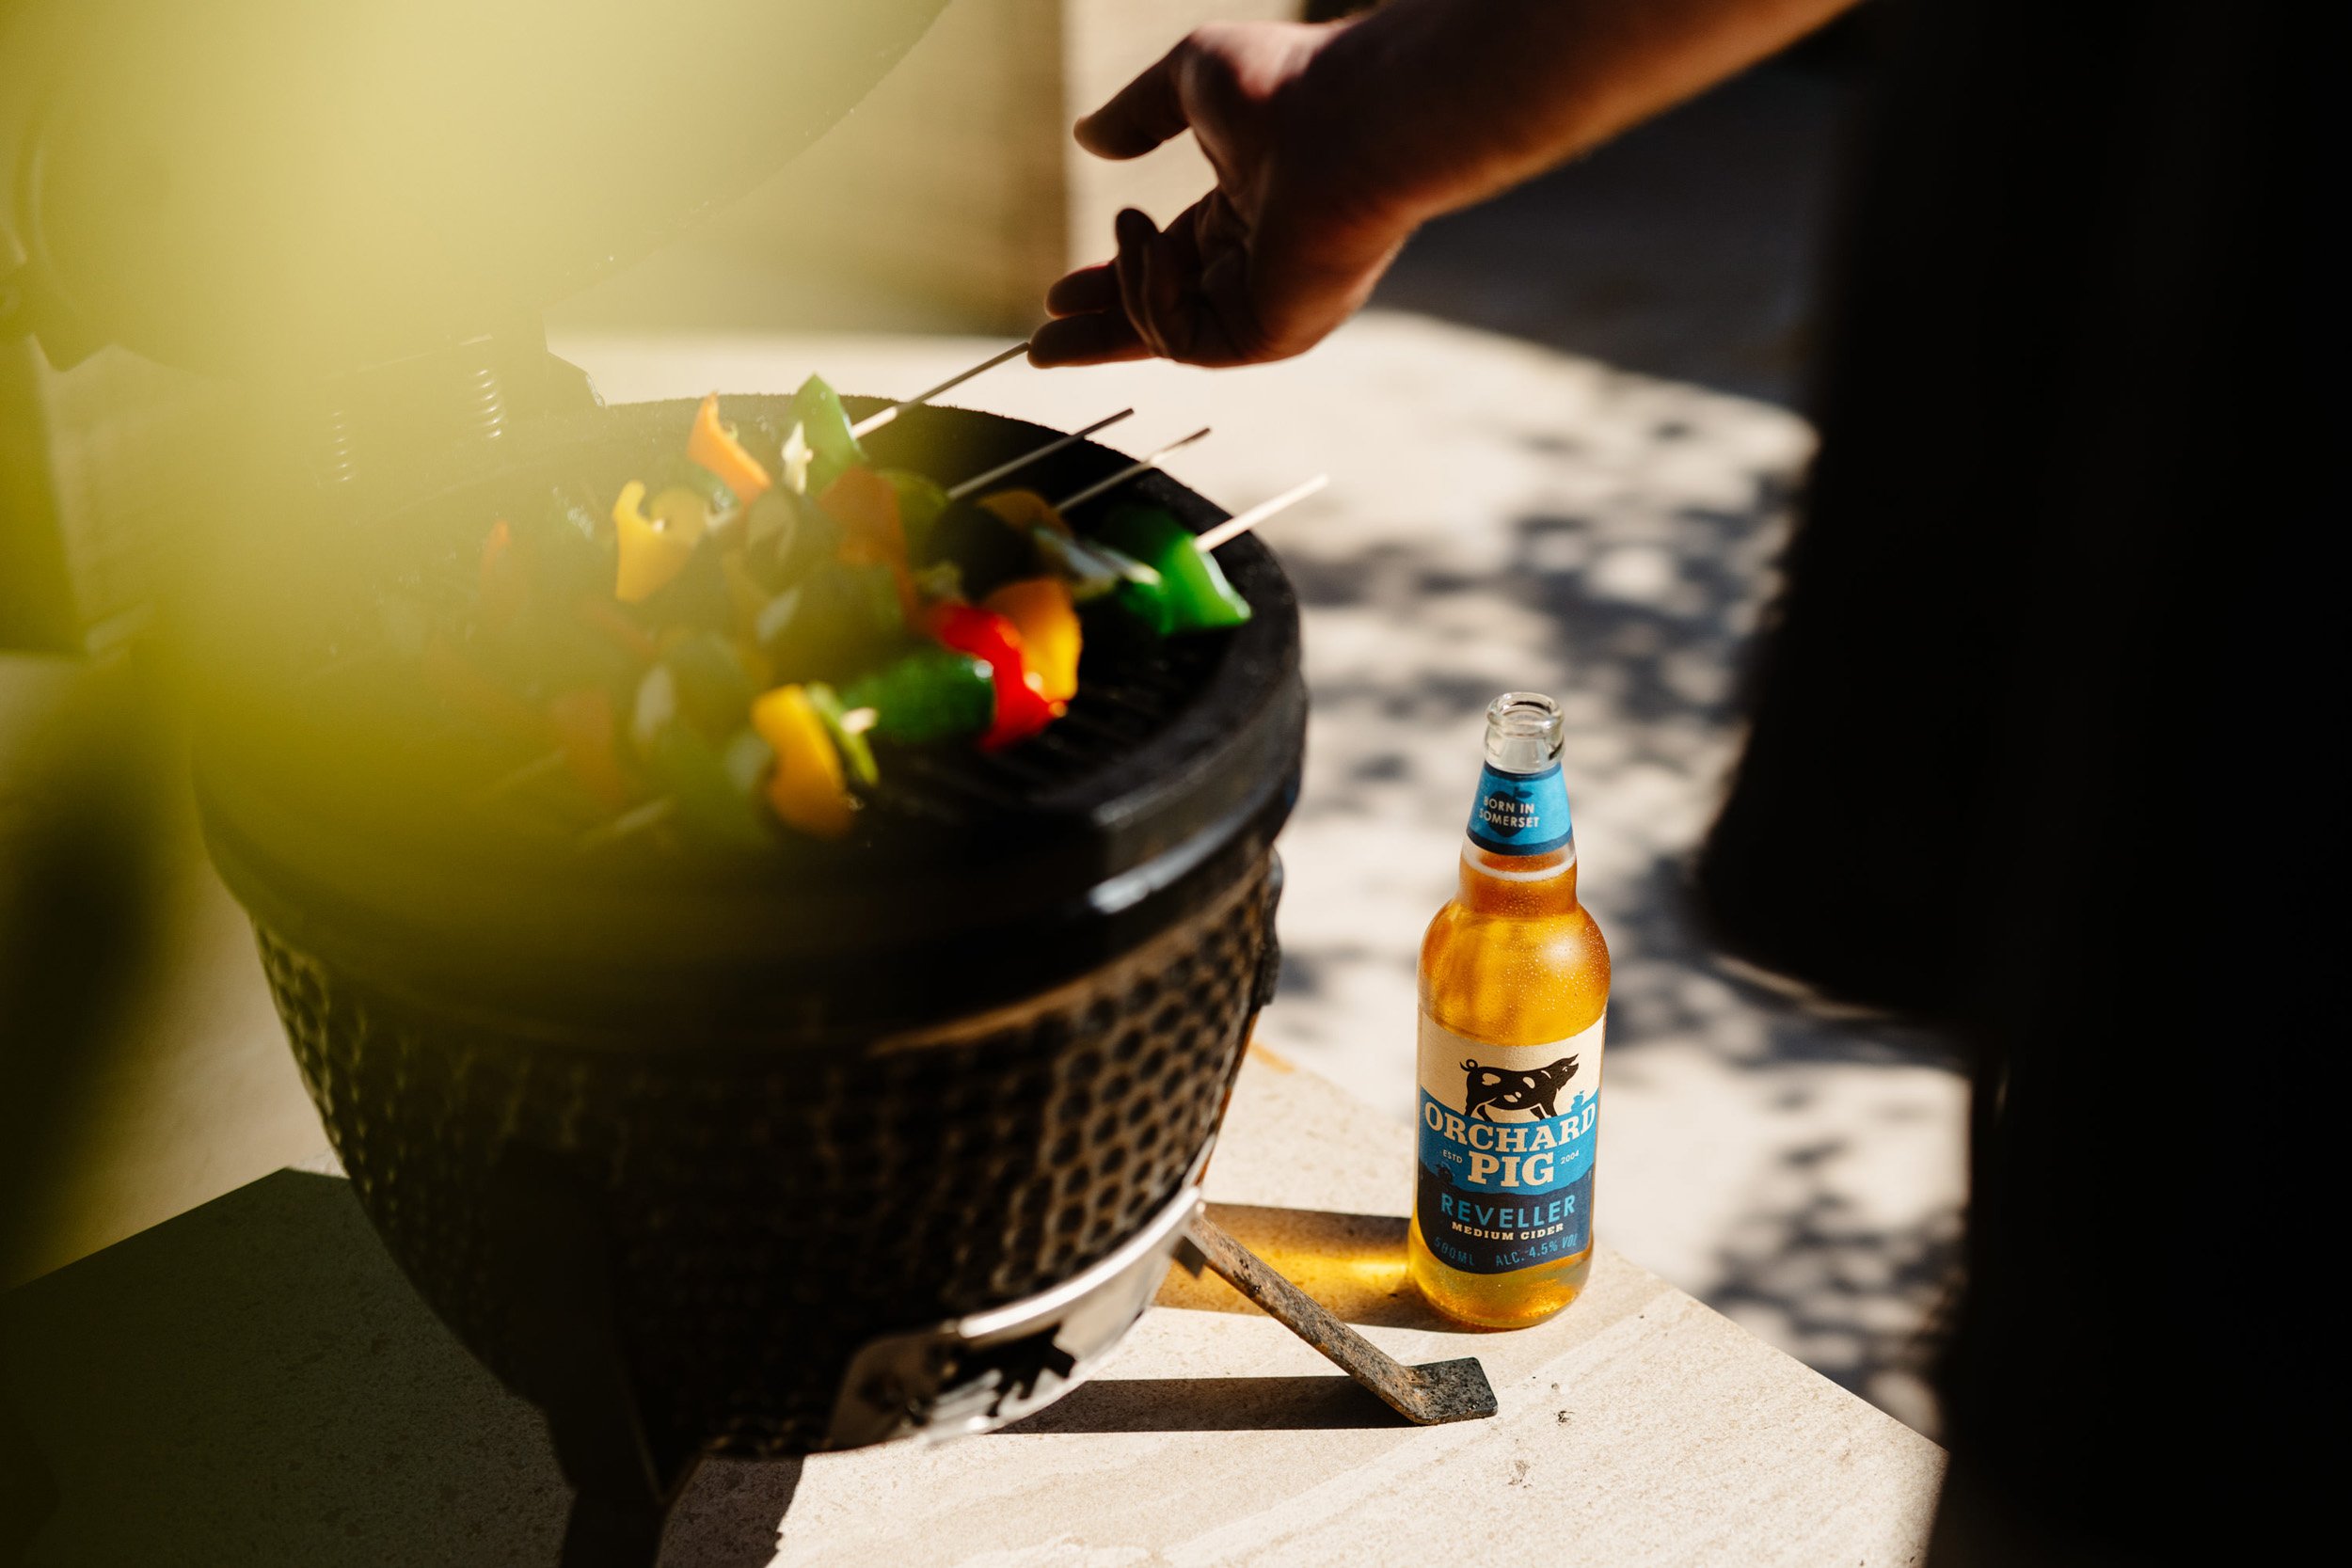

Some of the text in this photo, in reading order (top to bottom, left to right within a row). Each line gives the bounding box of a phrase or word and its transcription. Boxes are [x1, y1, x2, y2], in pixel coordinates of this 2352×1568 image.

[1484, 796, 1534, 814] BORN IN
[1479, 808, 1540, 828] SOMERSET
[1424, 1101, 1596, 1152] ORCHARD
[1442, 1149, 1580, 1187] ESTD PIG 2004
[1441, 1193, 1576, 1228] REVELLER
[1452, 1221, 1564, 1241] MEDIUM CIDER
[1434, 1236, 1475, 1266] 500ML
[1529, 1239, 1558, 1259] 4.5%
